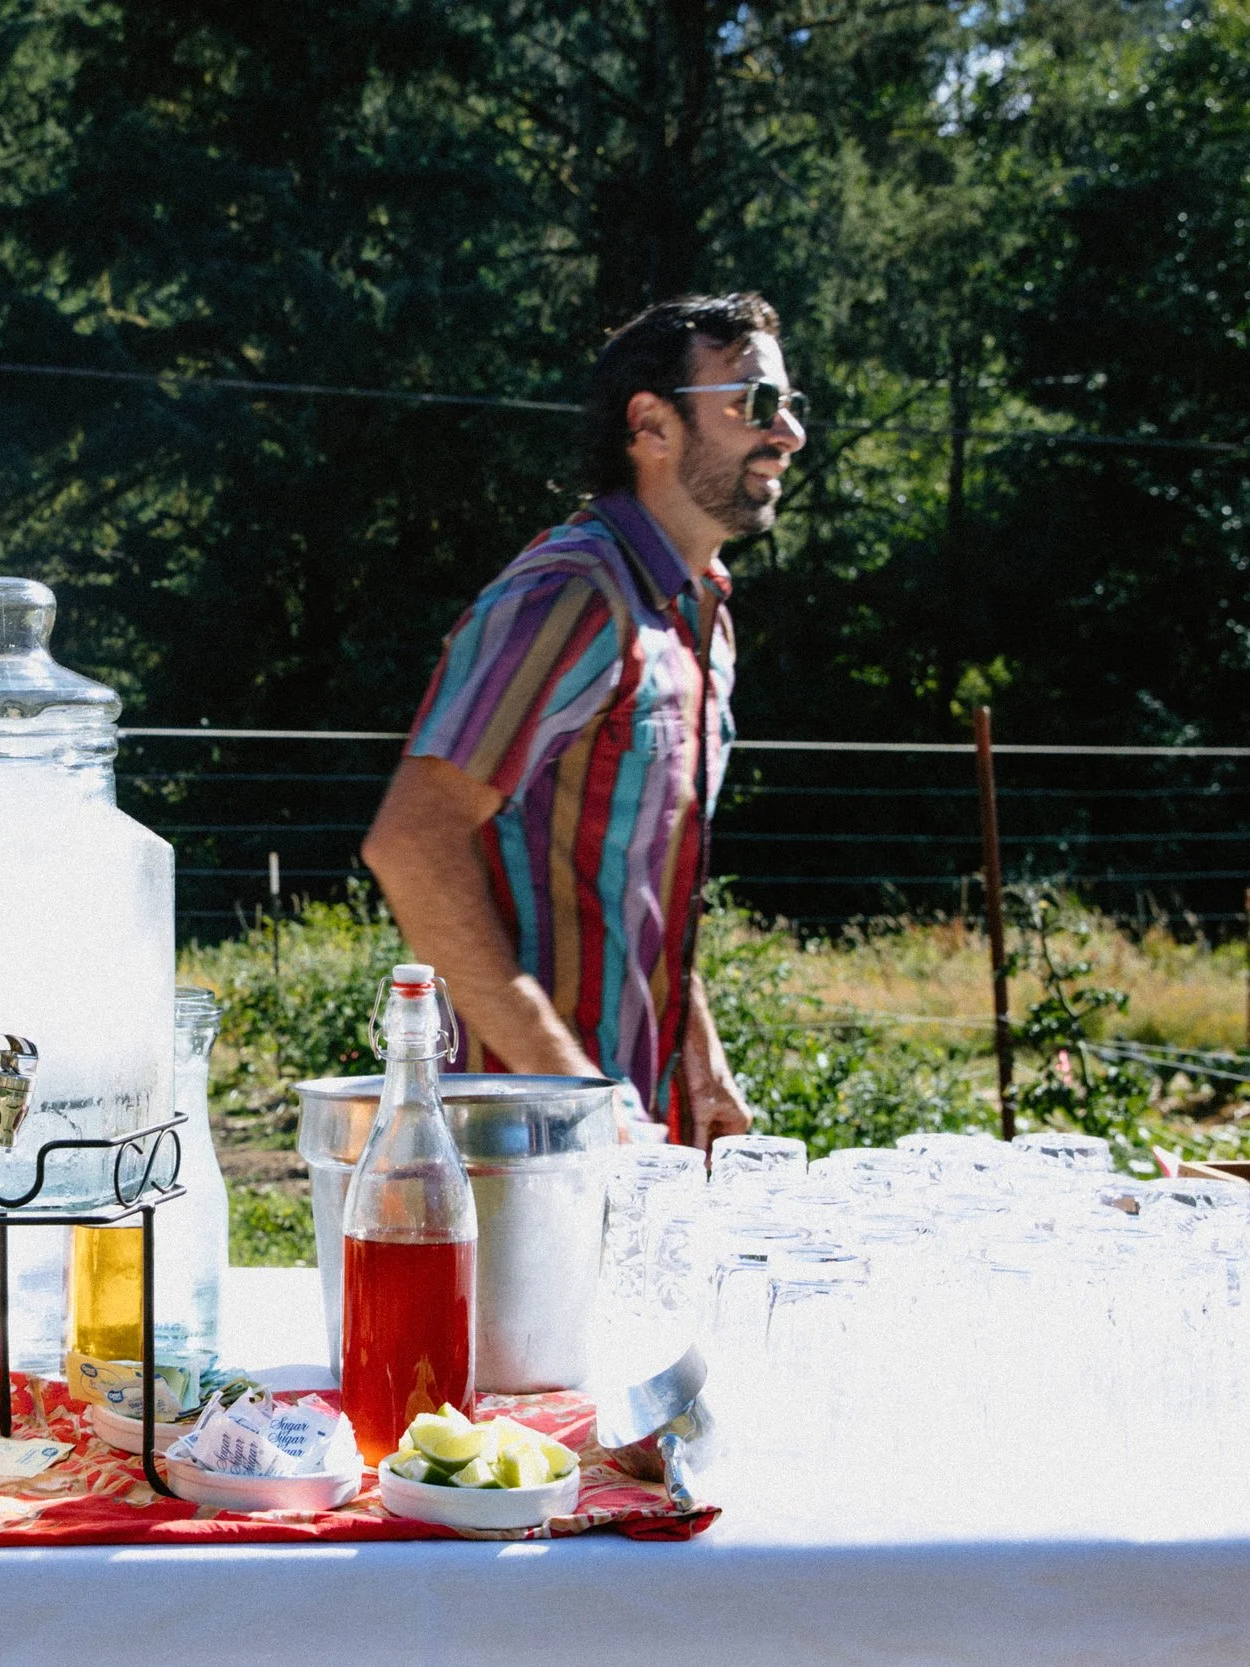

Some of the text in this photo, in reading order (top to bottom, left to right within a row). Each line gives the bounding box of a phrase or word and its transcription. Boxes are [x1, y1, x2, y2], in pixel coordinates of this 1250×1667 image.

[270, 1416, 309, 1433] Sugar
[214, 1431, 234, 1472] Sugar
[268, 1431, 306, 1447] Sugar
[228, 1436, 248, 1475] Sugar
